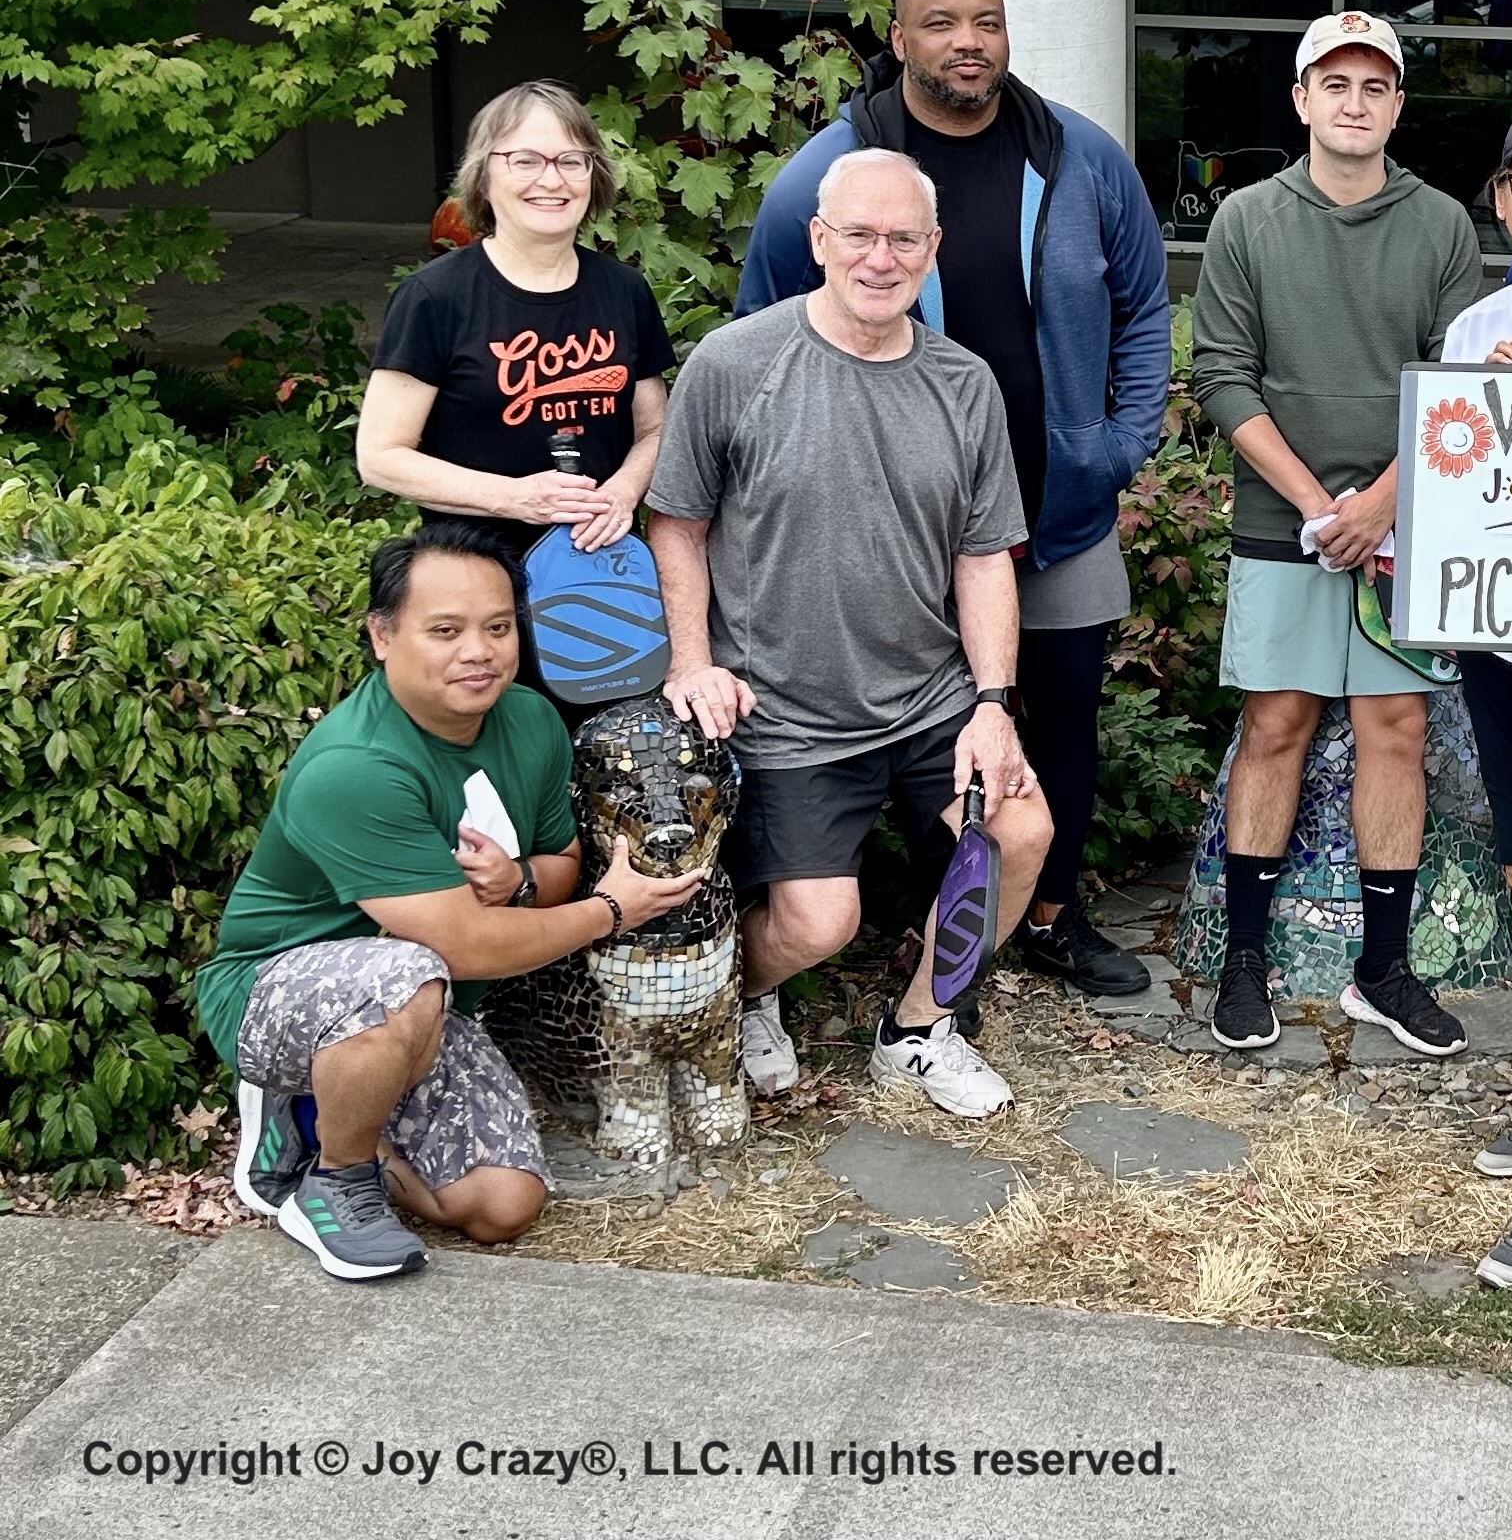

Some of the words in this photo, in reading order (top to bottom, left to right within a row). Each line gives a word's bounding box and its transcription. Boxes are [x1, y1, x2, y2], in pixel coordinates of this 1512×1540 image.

[1180, 193, 1208, 217] Be
[489, 328, 616, 426] Goss
[541, 400, 578, 421] GOT
[583, 396, 615, 416] 'EM
